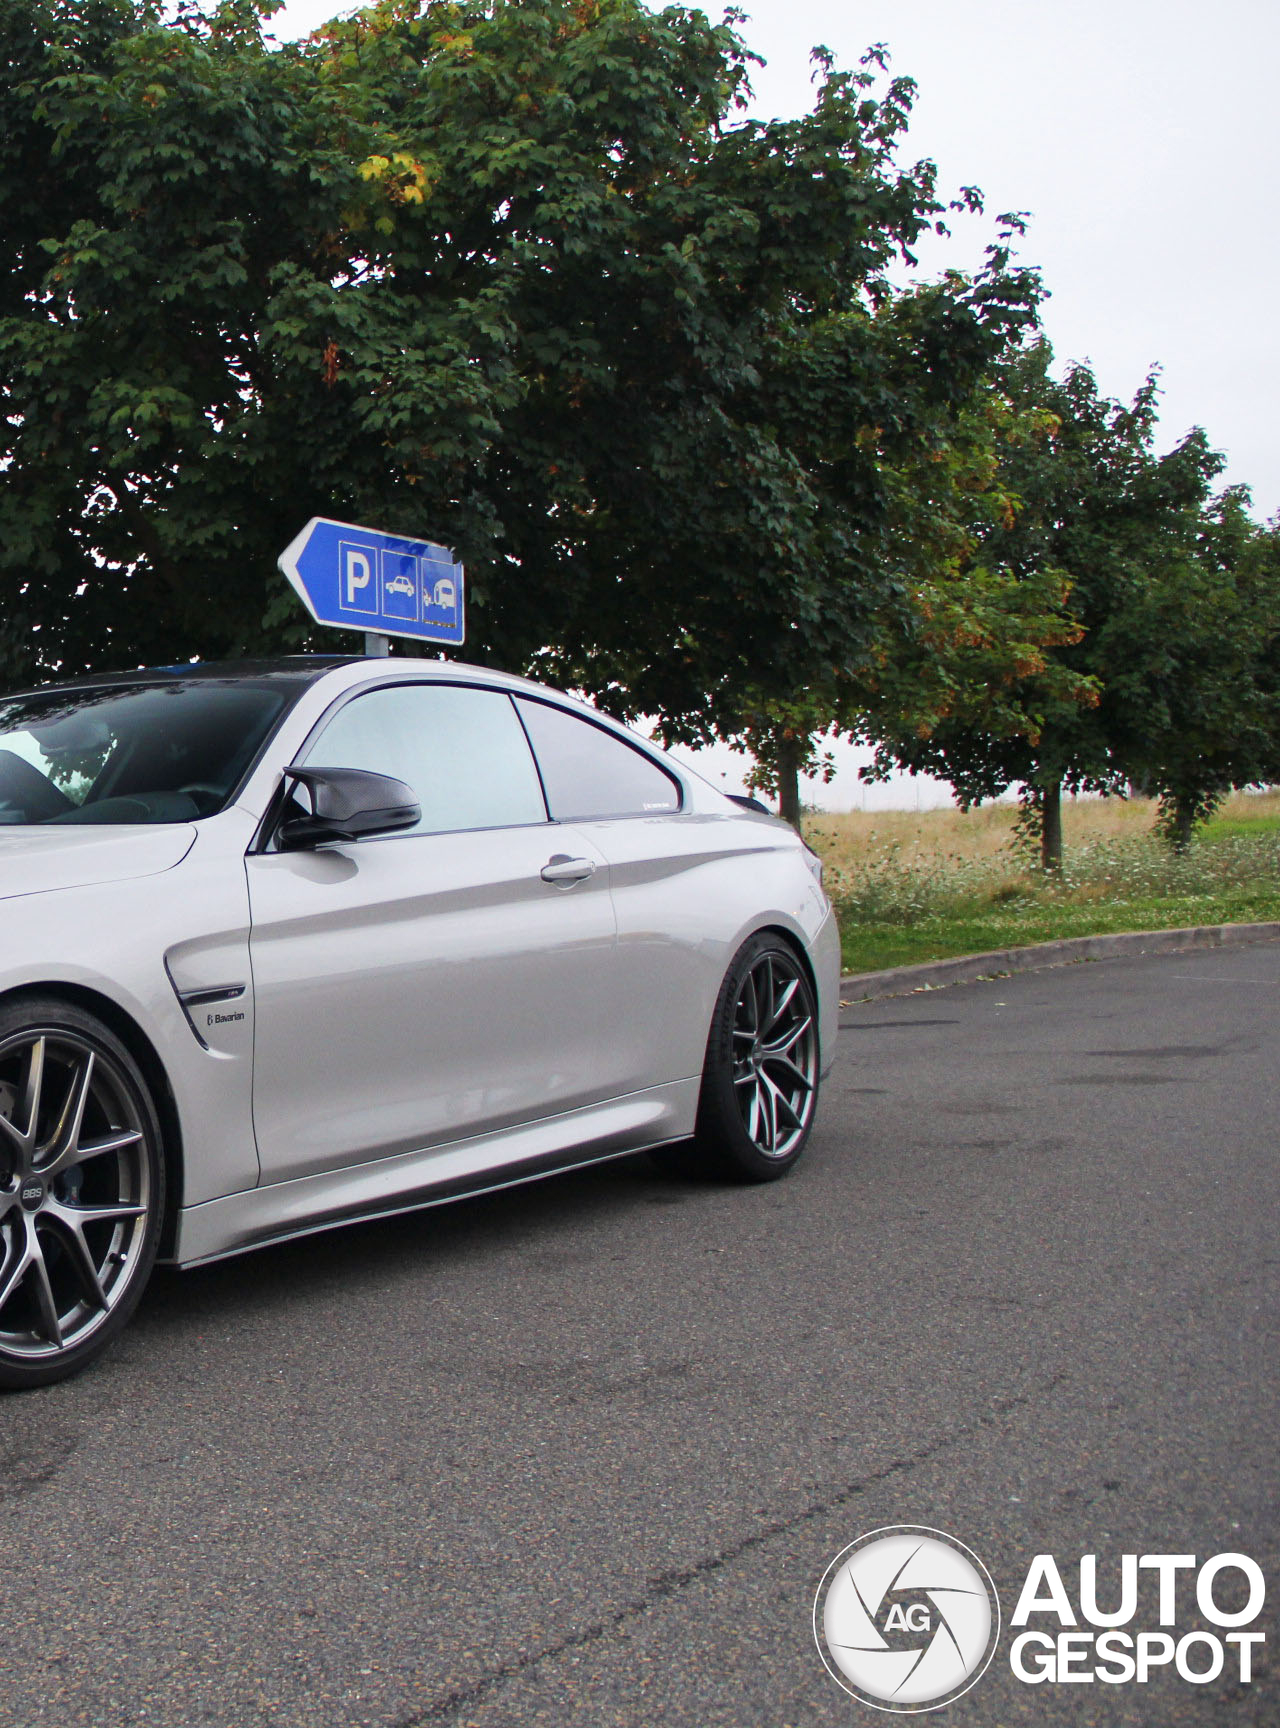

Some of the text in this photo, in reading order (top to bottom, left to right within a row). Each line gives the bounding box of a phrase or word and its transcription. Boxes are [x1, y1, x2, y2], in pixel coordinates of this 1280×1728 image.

[347, 551, 370, 603] P
[215, 1012, 244, 1023] Bavarian
[23, 1188, 42, 1199] BBS
